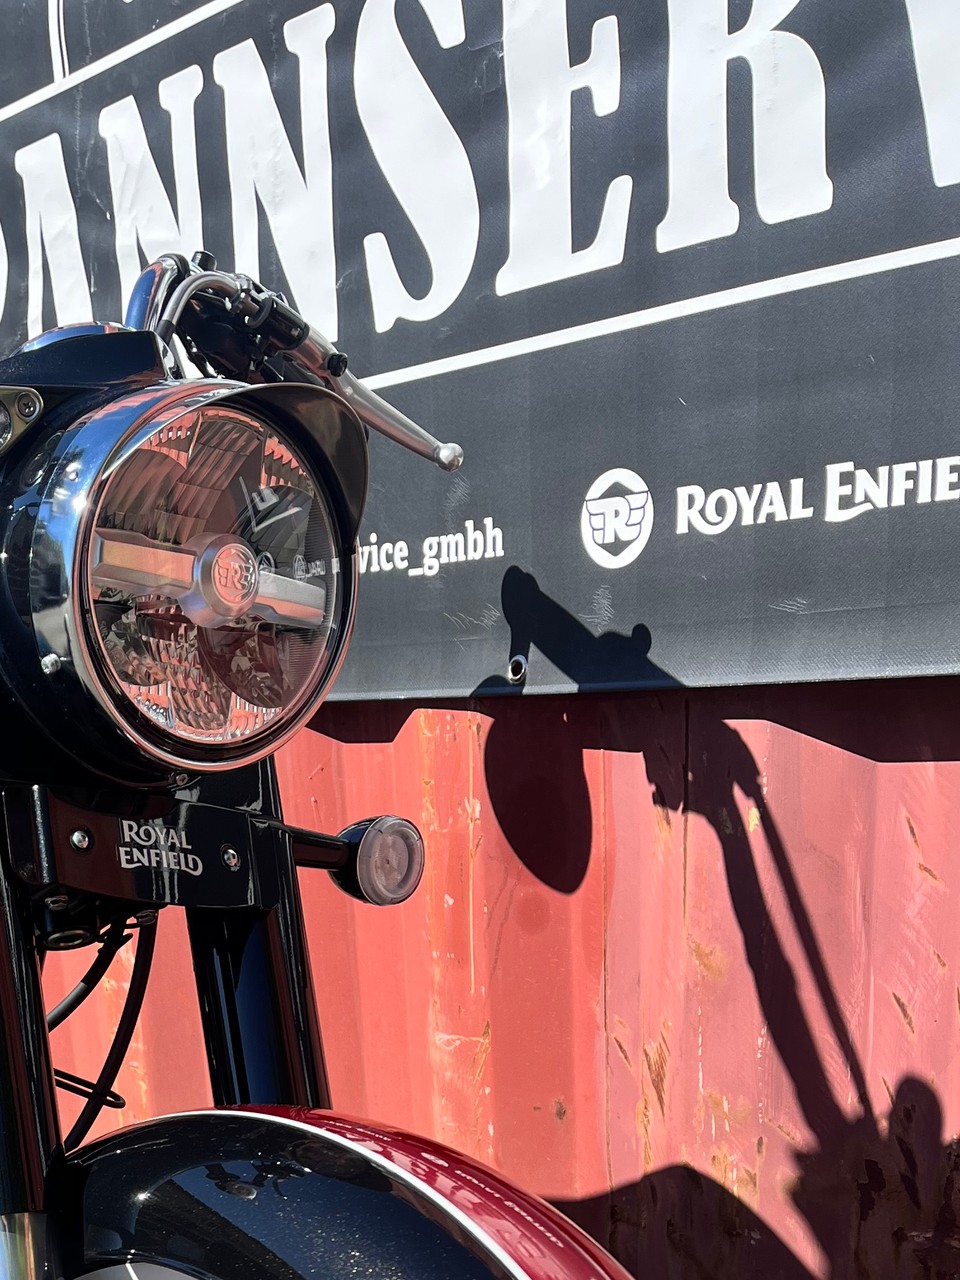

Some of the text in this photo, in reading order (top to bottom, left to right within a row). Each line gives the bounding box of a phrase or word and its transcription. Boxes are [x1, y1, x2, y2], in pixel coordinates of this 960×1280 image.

[675, 455, 960, 535] ROYAL ENFIE
[121, 819, 192, 850] ROYAL
[118, 846, 204, 877] ENFIELD
